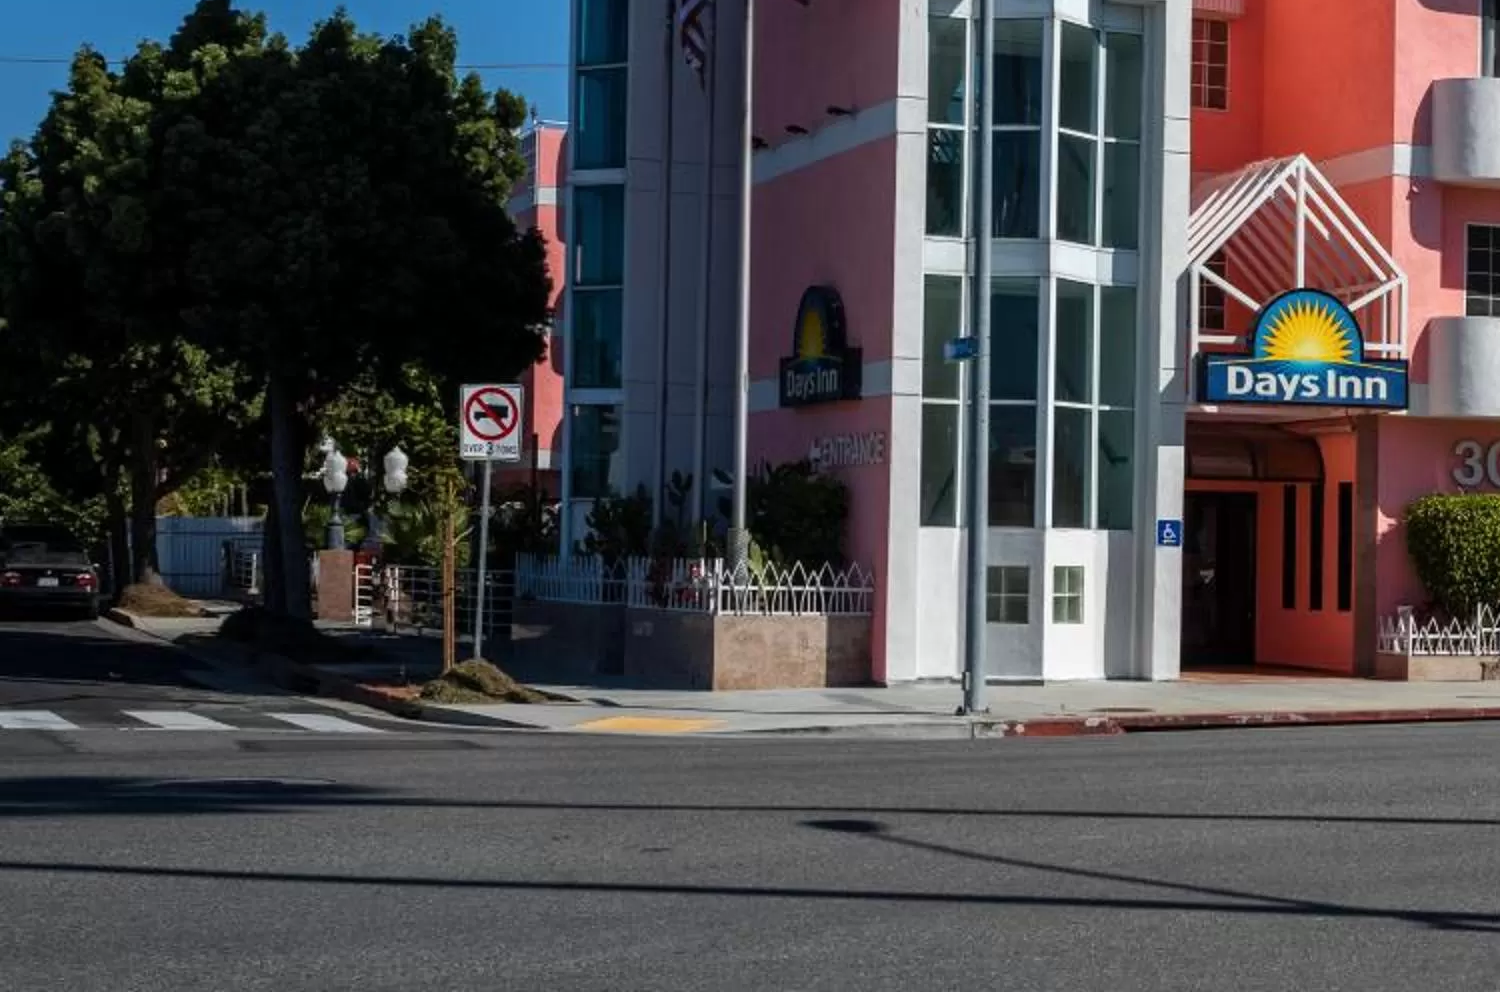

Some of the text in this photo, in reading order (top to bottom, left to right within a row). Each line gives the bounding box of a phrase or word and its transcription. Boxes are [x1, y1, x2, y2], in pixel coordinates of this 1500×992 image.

[786, 367, 837, 399] Days Inn
[1227, 365, 1387, 400] Days Inn
[464, 443, 485, 453] OVER
[486, 441, 494, 455] 3
[821, 431, 885, 467] ENTRANCE
